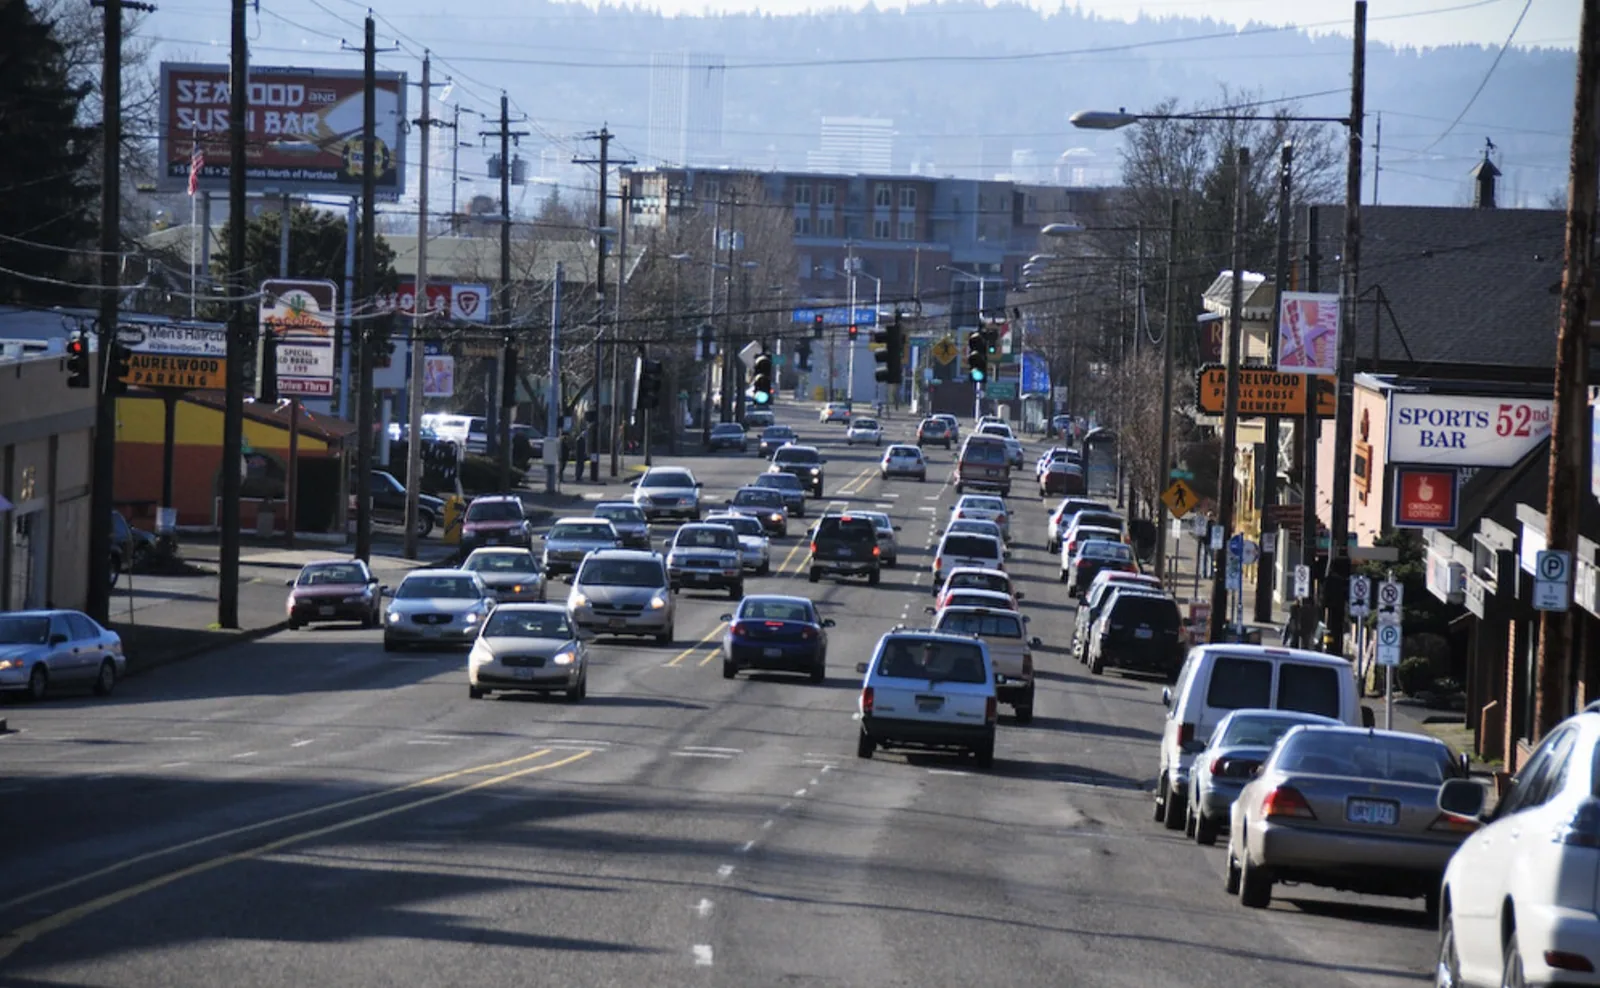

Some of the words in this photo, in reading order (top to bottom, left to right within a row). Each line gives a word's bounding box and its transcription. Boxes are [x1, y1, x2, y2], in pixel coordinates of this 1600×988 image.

[177, 79, 305, 107] SEAOOD
[177, 107, 255, 131] SUSI
[264, 111, 319, 135] BAR
[134, 372, 208, 387] PARKING
[303, 382, 328, 393] Thru
[1209, 373, 1300, 386] LARELWOOD
[1398, 408, 1490, 429] SPORTS
[1496, 403, 1550, 438] 52nd
[1419, 430, 1467, 449] BAR
